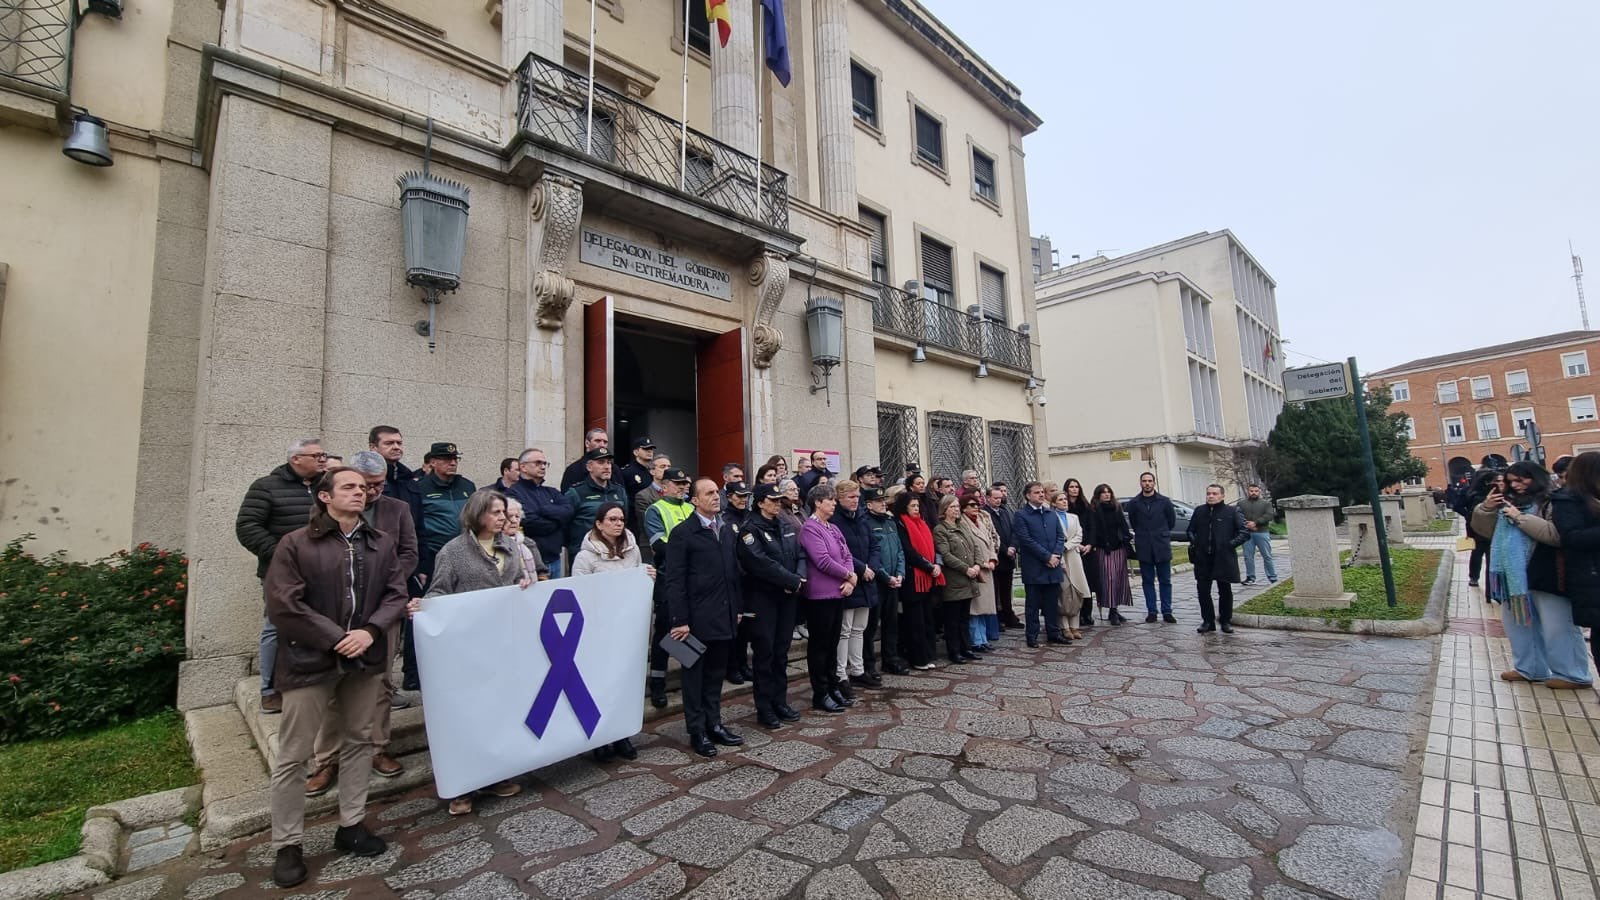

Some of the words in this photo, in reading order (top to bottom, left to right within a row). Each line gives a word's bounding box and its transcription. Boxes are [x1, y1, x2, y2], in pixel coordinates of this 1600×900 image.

[584, 231, 651, 259] DELEGACION
[658, 253, 677, 268] DEL
[685, 262, 730, 283] GOBIERNO
[612, 255, 628, 269] EN
[635, 262, 709, 291] EXTREMADURA
[1308, 386, 1343, 394] Gobierno
